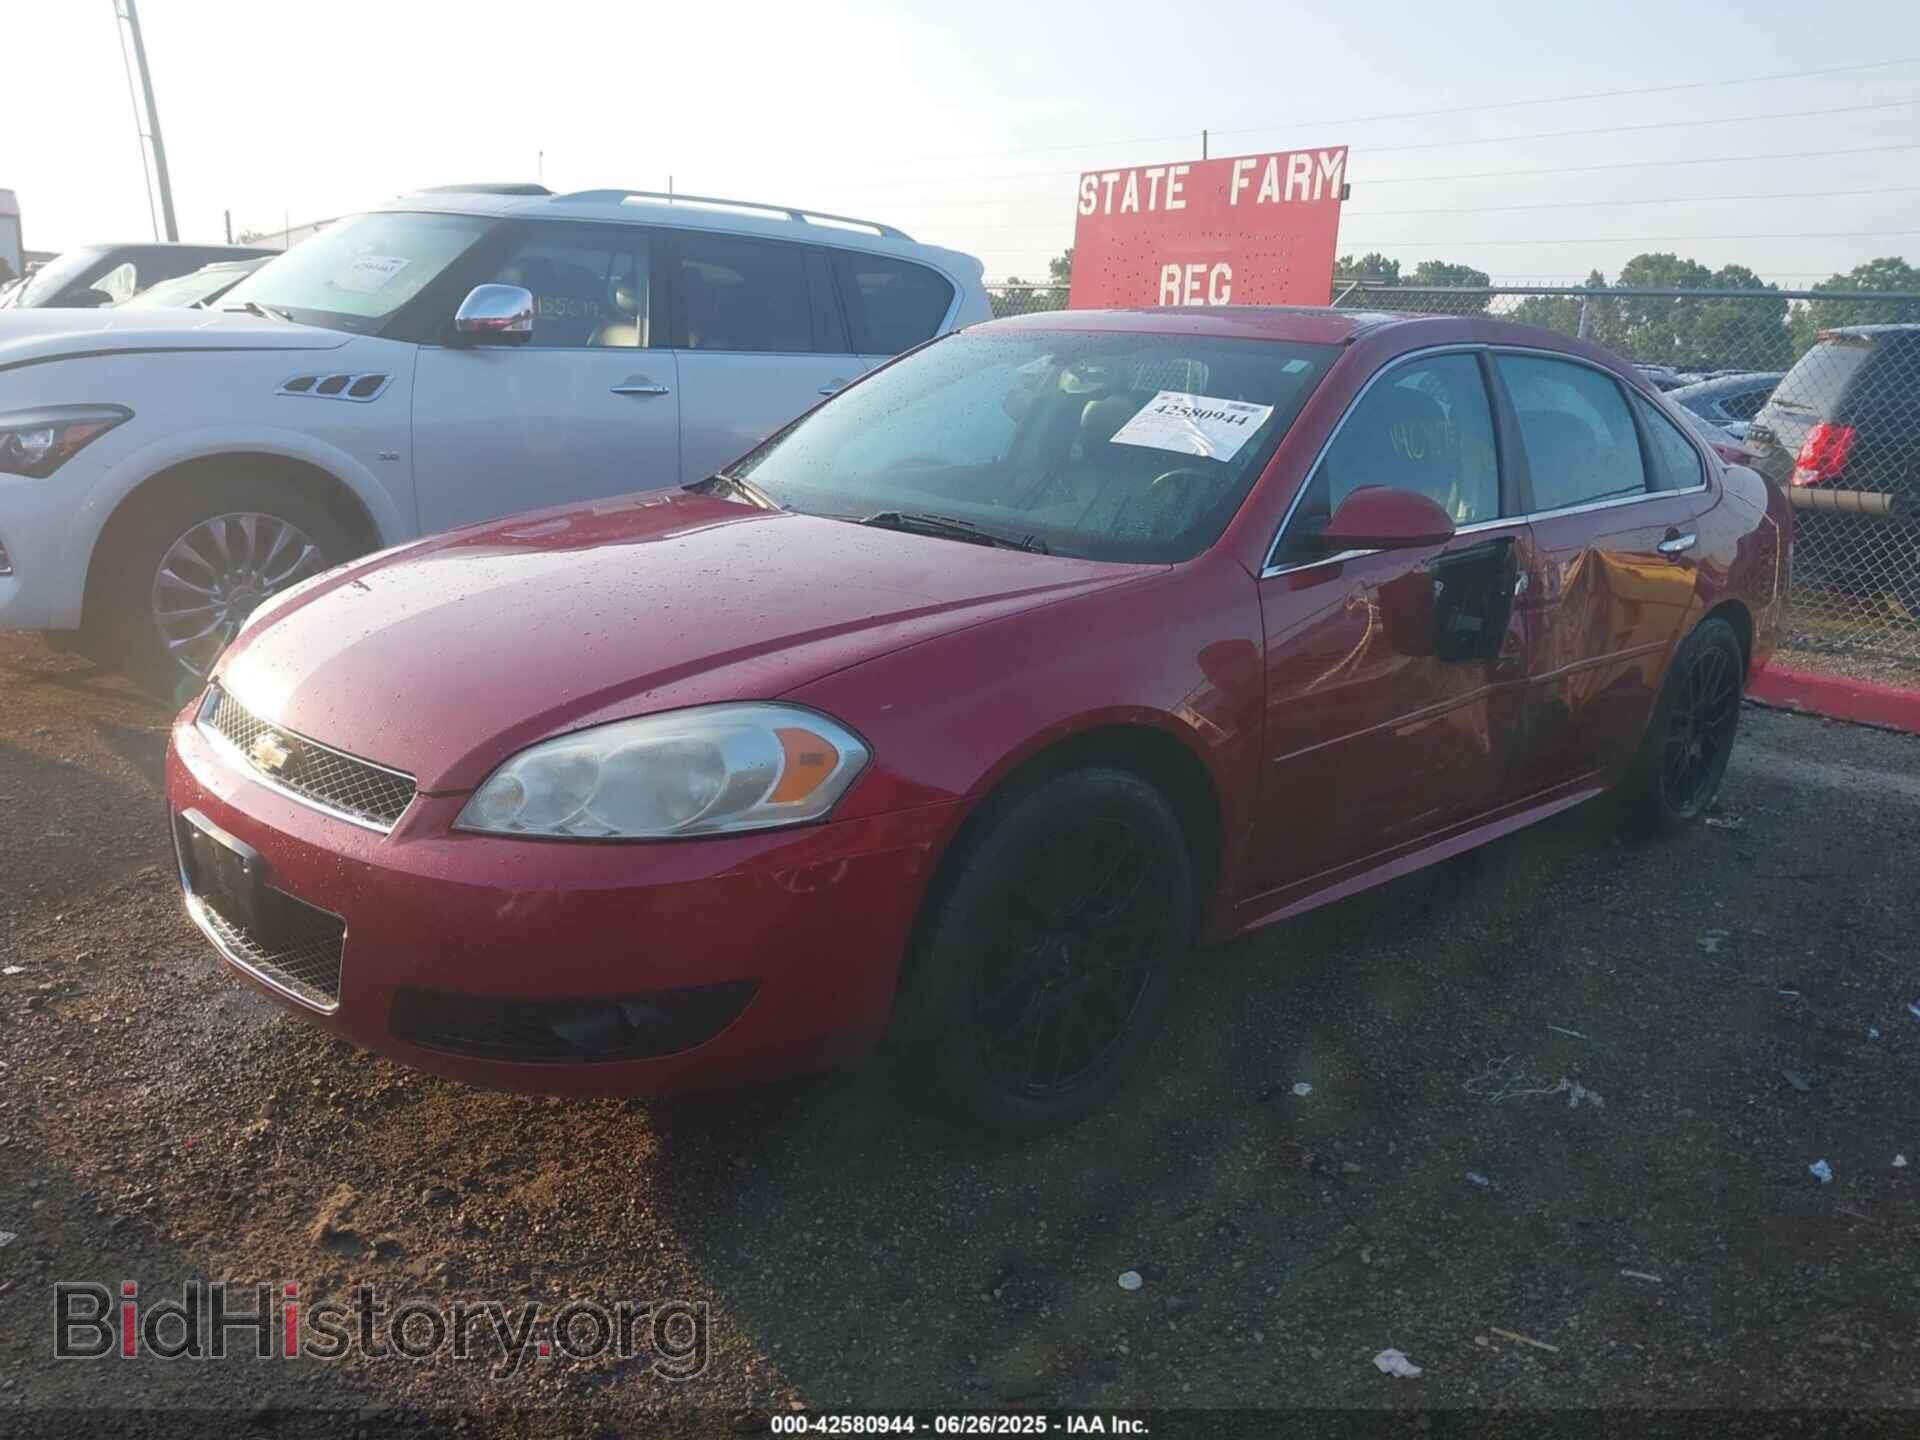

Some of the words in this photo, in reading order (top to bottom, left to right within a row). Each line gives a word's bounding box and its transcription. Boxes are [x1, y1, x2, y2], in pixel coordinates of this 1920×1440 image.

[1078, 165, 1190, 215] STATE
[1229, 150, 1345, 206] FARM
[1159, 263, 1233, 307] REG
[1155, 404, 1248, 426] 42580944
